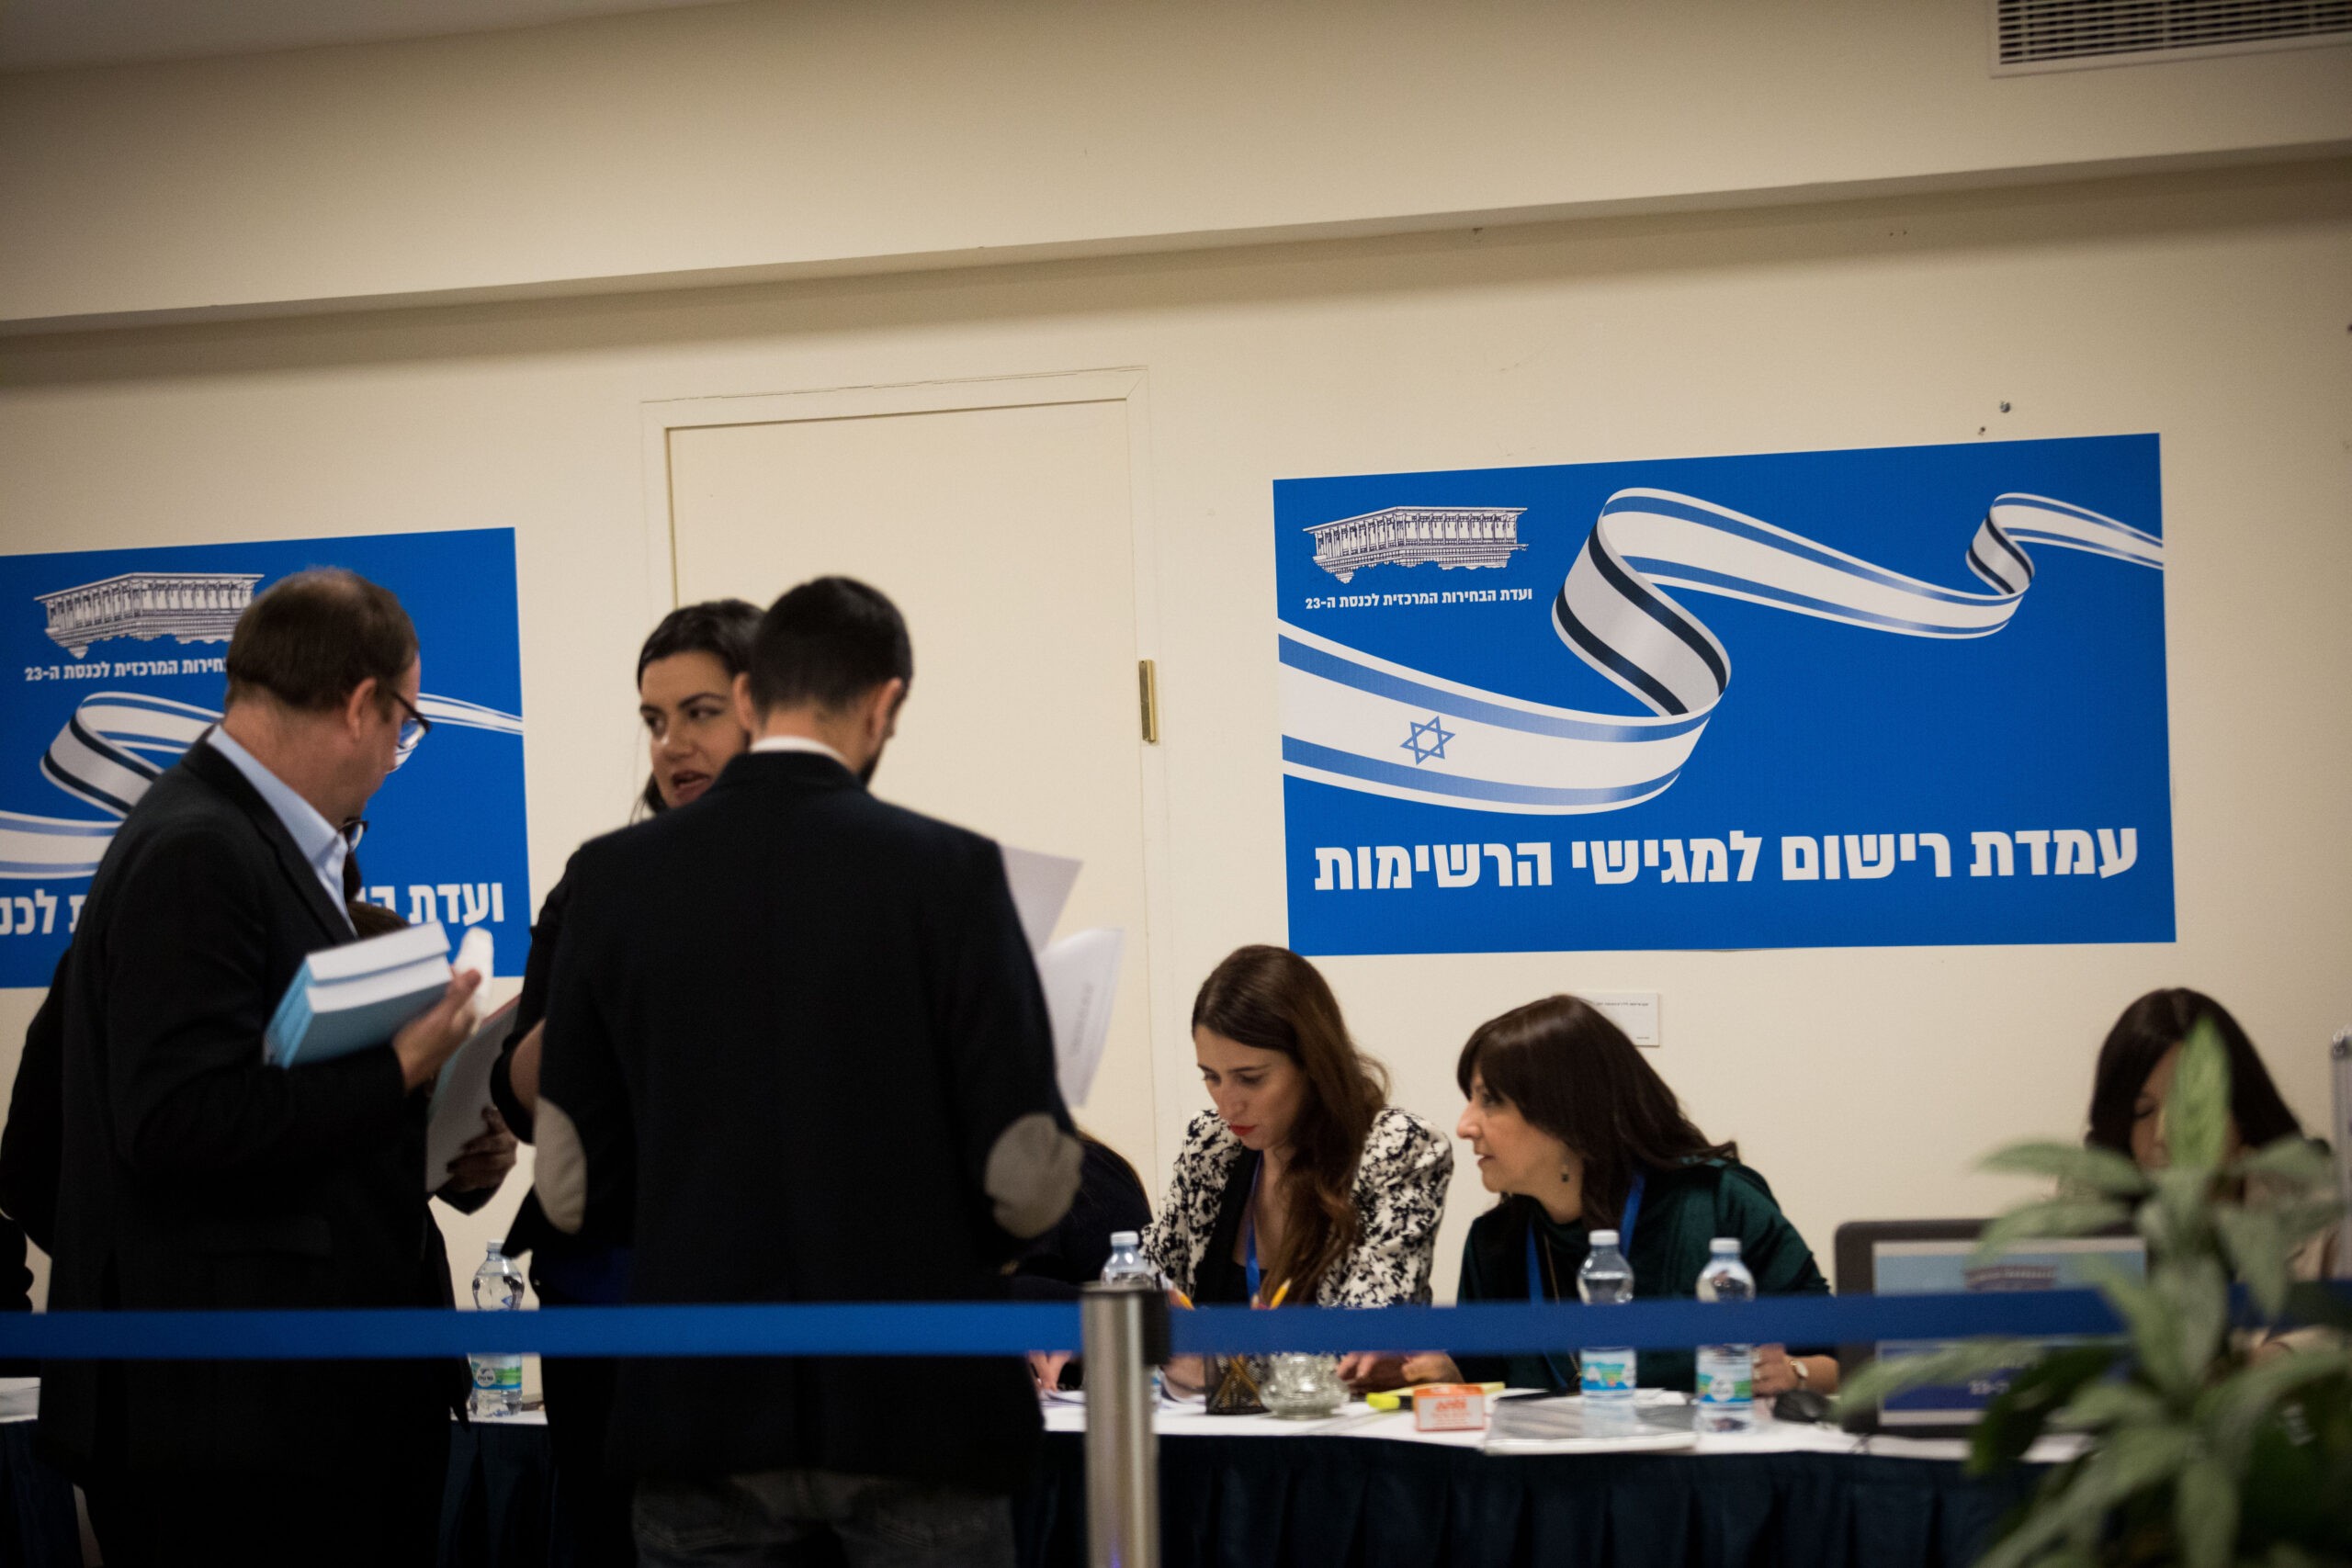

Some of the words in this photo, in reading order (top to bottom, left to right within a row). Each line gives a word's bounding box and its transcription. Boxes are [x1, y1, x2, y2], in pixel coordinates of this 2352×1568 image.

[1305, 596, 1336, 610] ה-23
[1339, 592, 1380, 608] לכנסת
[1383, 592, 1439, 606] המרכזית
[1442, 590, 1497, 604] הבחירות
[1499, 588, 1532, 602] ועדת
[63, 660, 111, 680] לכנסת
[114, 660, 178, 678] המרכזית
[182, 658, 227, 674] חירות
[1571, 829, 1763, 885] למגישי
[1781, 832, 1951, 881] רישום
[1969, 828, 2138, 879] עמדת
[1314, 841, 1553, 891] הרשימות
[408, 882, 504, 926] ועדת
